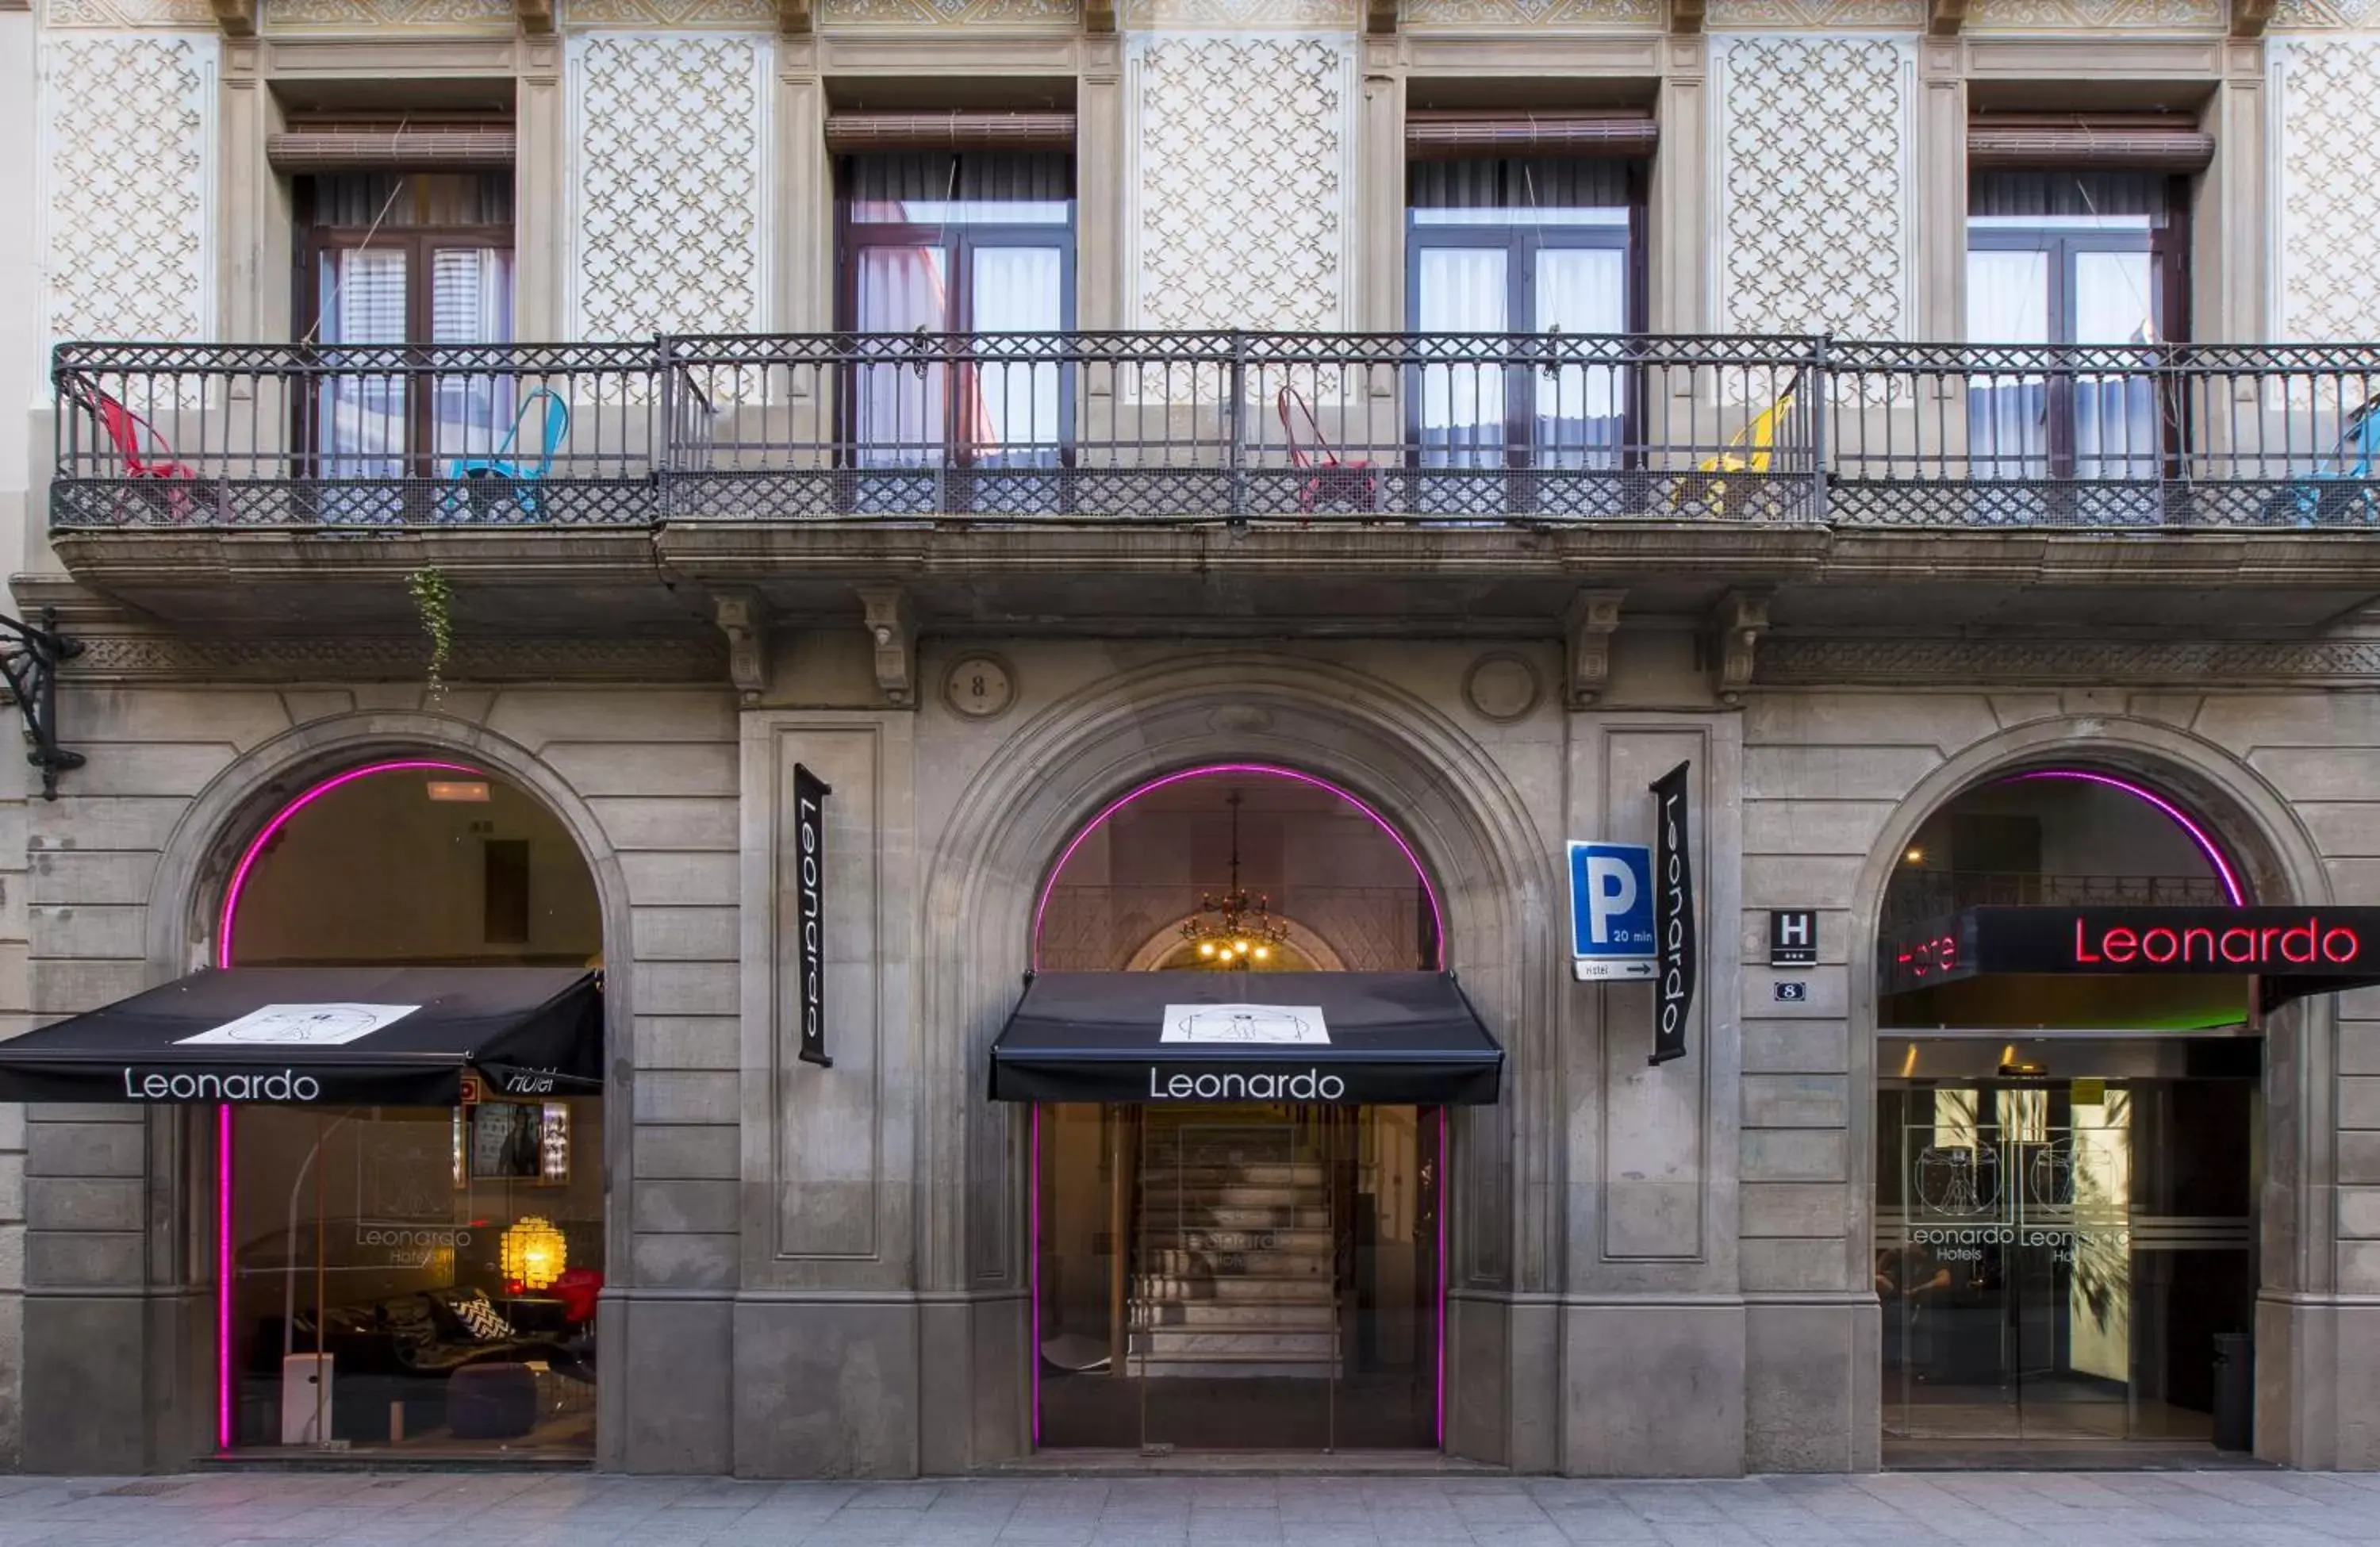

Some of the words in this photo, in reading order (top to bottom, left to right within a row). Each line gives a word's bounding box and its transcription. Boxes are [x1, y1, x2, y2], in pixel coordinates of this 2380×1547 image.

[972, 675, 985, 697] 8
[1587, 856, 1637, 943] P
[1663, 794, 1684, 1035] Leonardo
[800, 797, 818, 1038] Leonardo
[1782, 915, 1808, 945] H
[1614, 931, 1629, 942] 20
[1633, 931, 1653, 942] min
[2075, 916, 2359, 963] Leonardo
[1783, 985, 1796, 998] 8
[125, 1067, 320, 1100] Leonardo
[1150, 1067, 1345, 1099] Leonardo
[1906, 1226, 2014, 1245] Leonardo
[1937, 1247, 1982, 1261] Hotels
